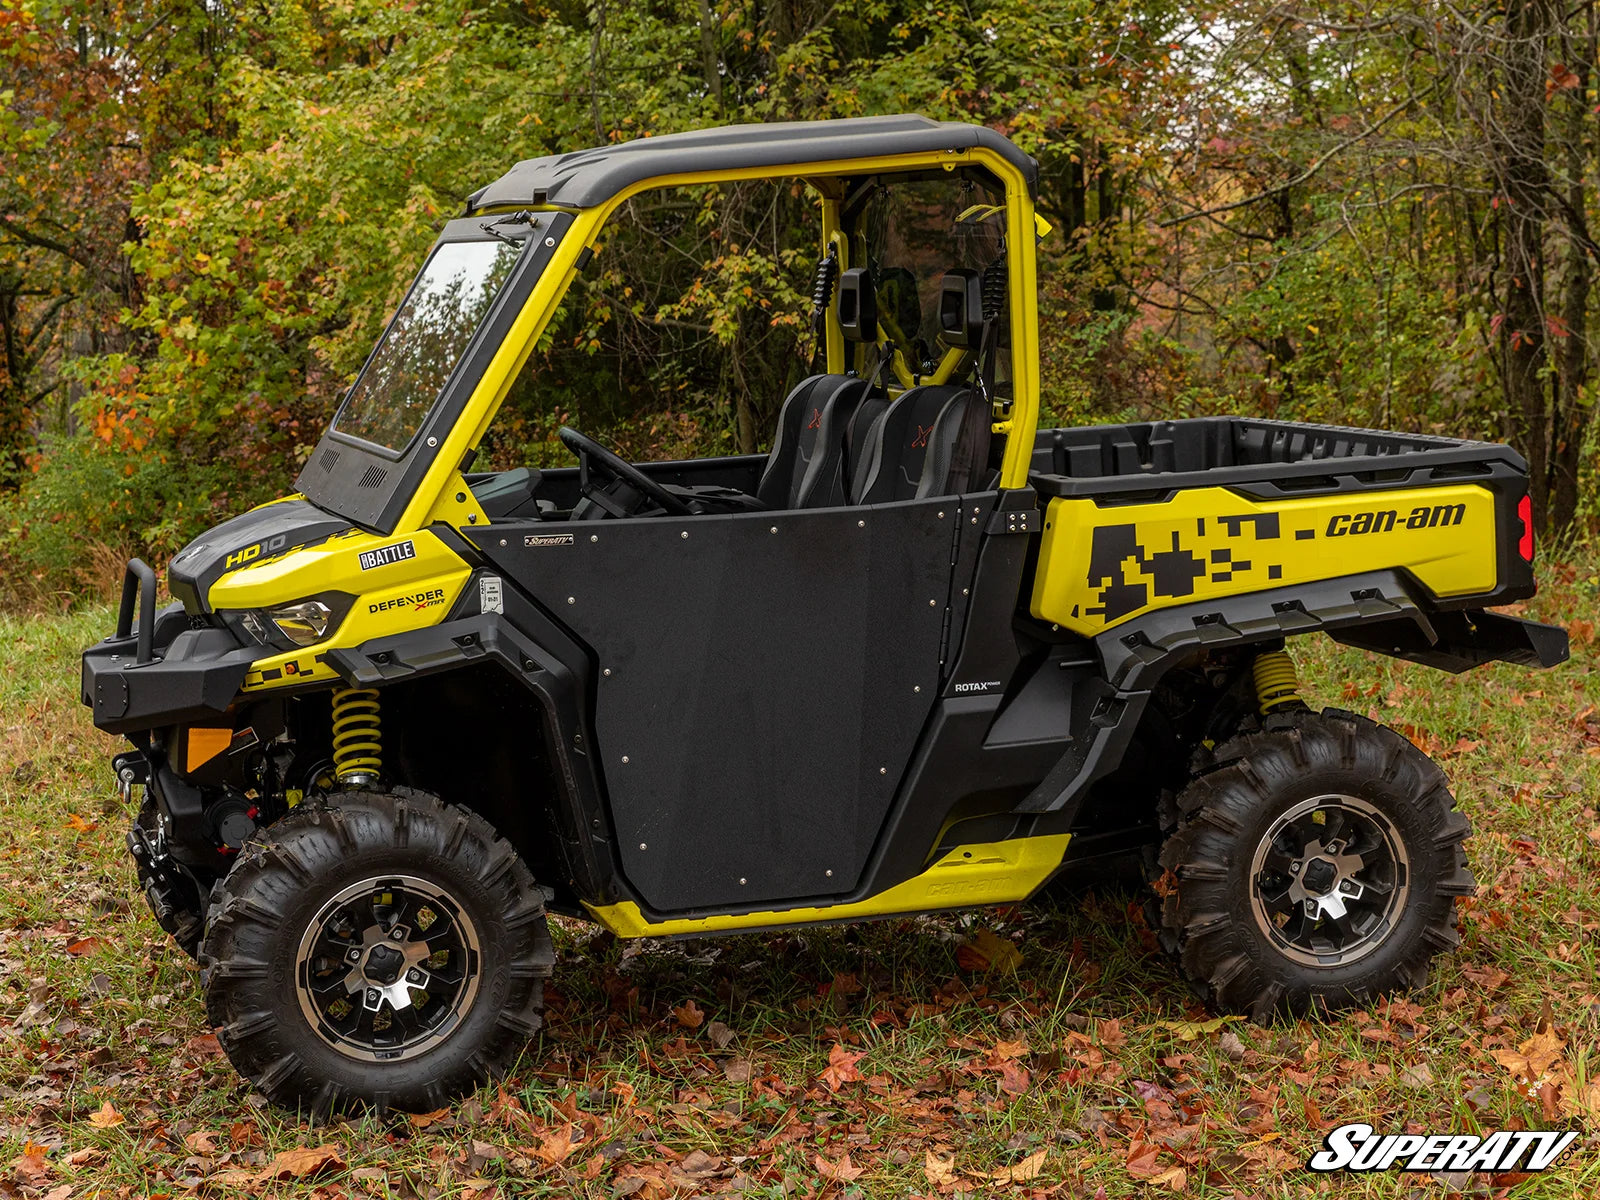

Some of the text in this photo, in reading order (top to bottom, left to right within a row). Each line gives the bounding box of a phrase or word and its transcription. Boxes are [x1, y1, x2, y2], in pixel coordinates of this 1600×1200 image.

[225, 534, 286, 569] HD10
[367, 543, 412, 567] BATTLE
[369, 589, 444, 614] DEFENDER
[955, 682, 988, 692] ROTAX
